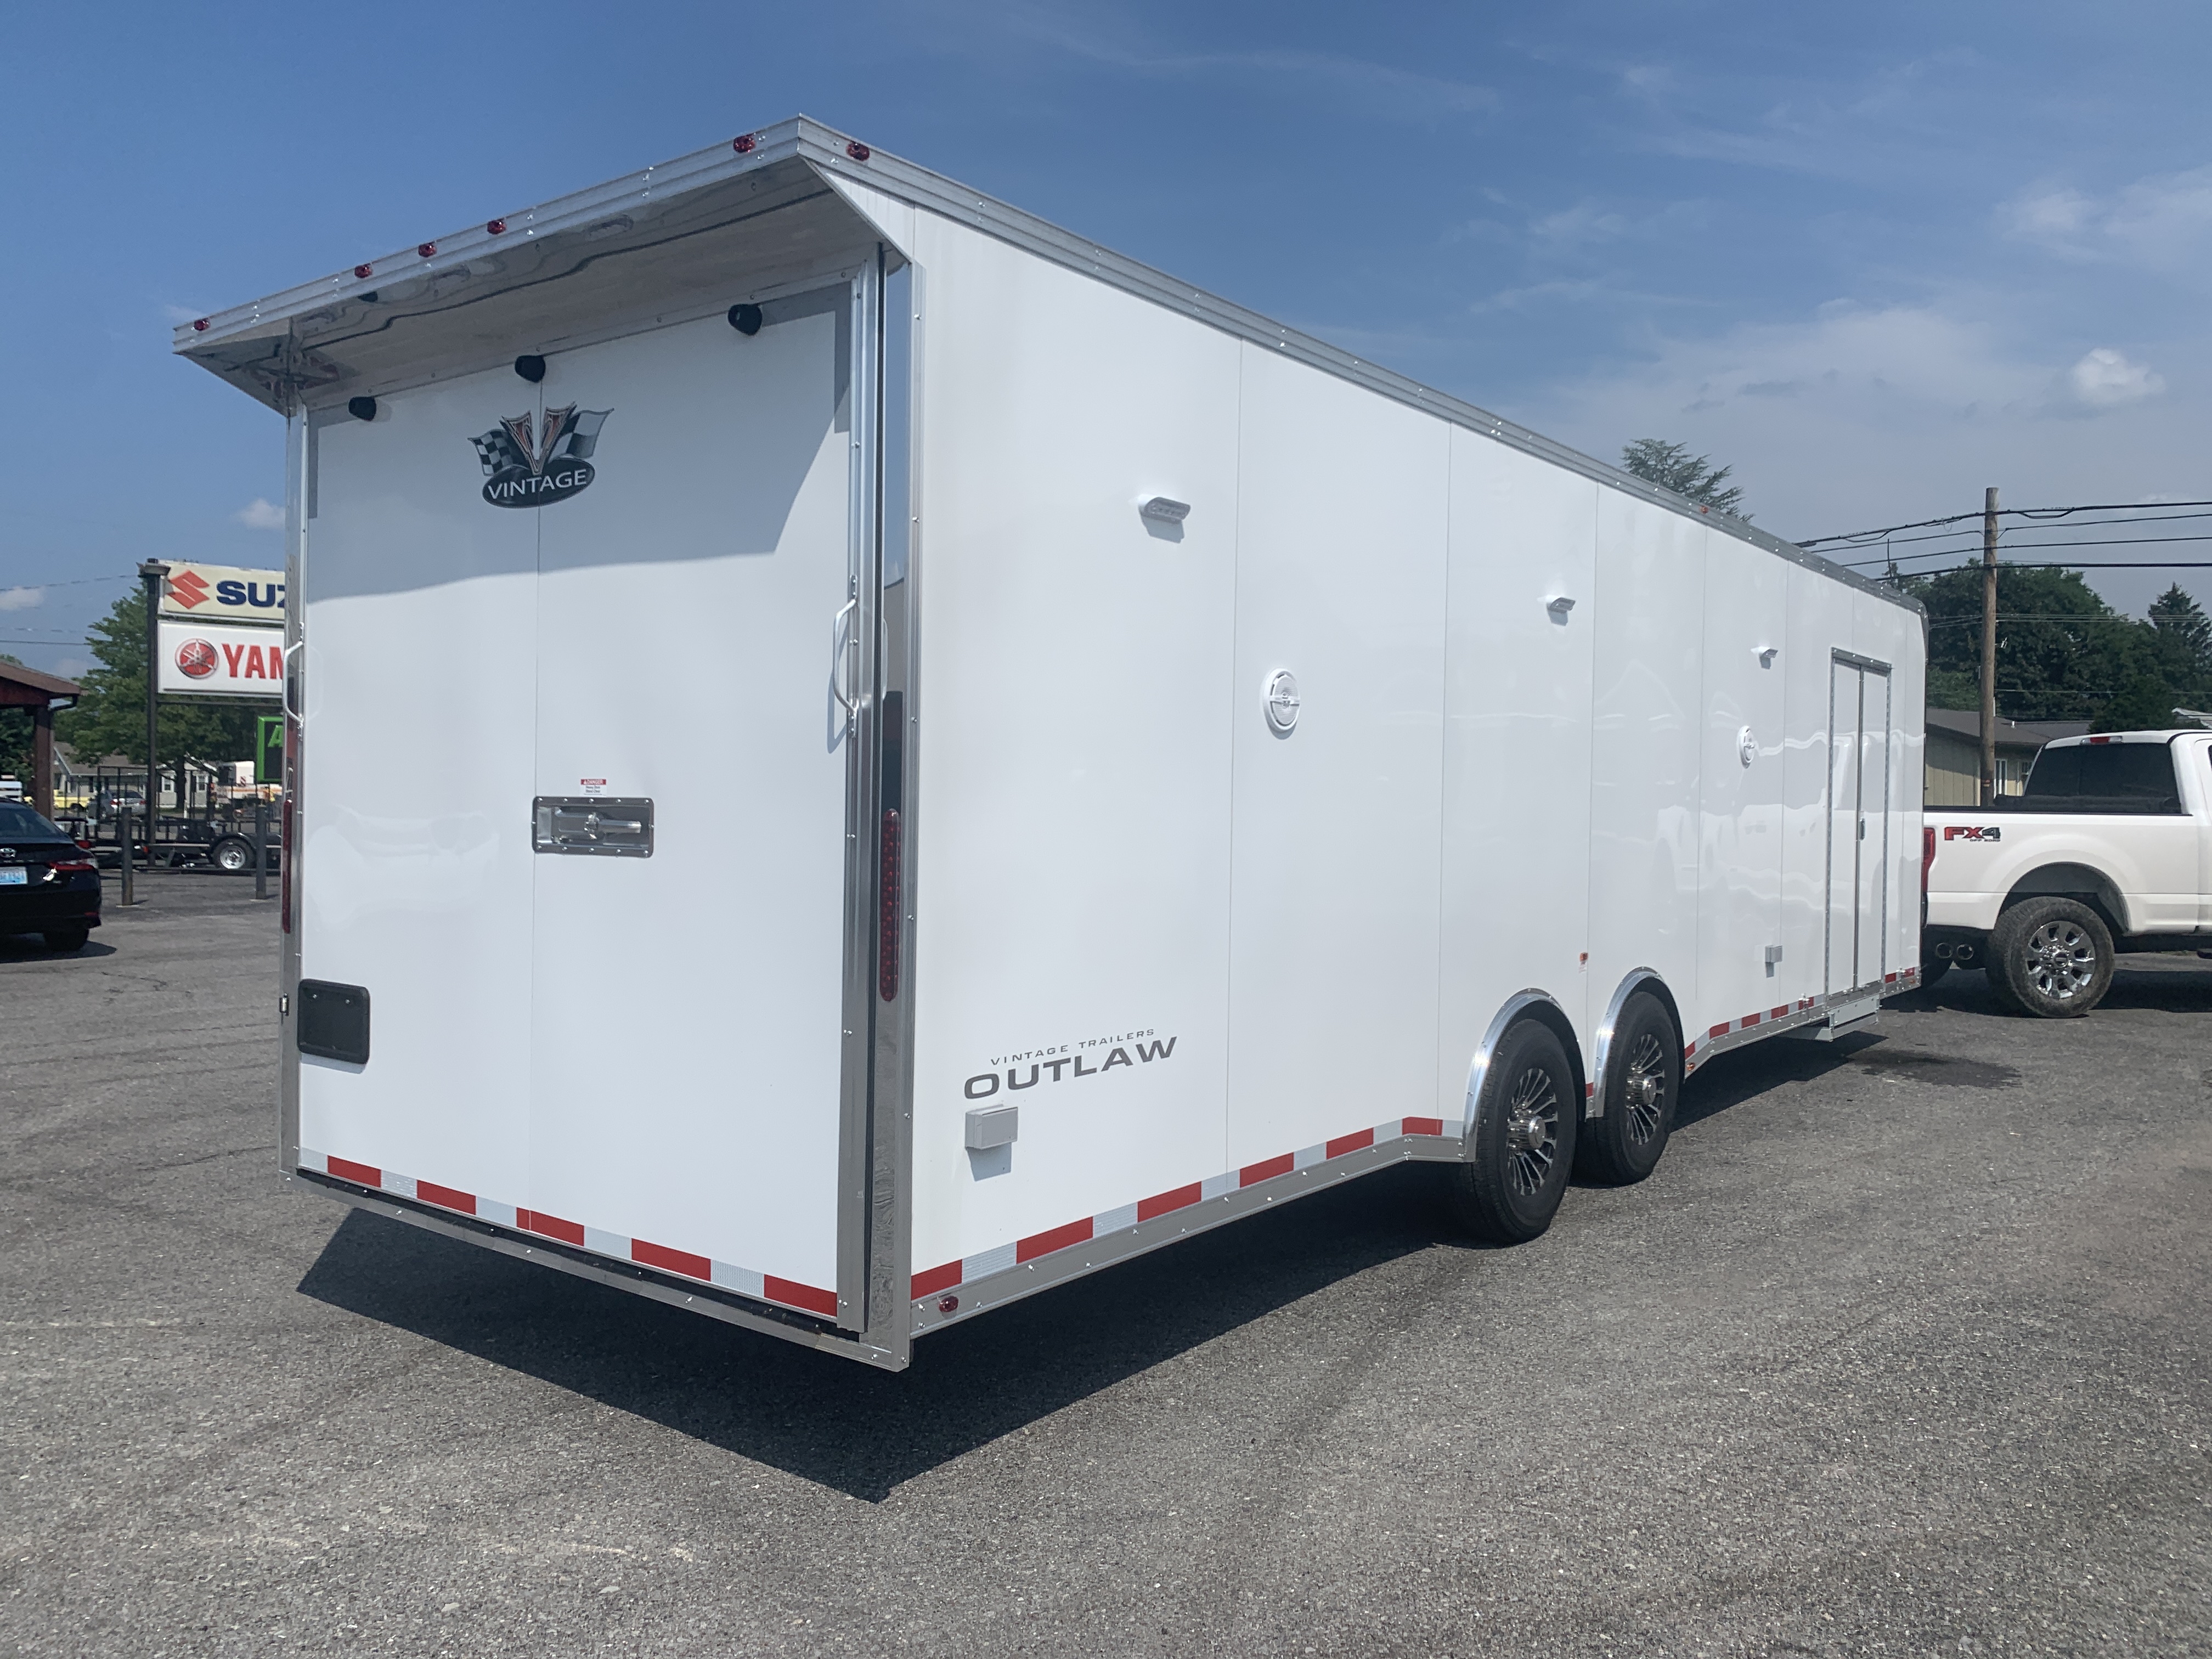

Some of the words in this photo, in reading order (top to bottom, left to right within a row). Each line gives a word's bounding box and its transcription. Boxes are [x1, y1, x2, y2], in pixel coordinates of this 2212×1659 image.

[488, 469, 587, 500] VINTAGE
[216, 580, 285, 609] SU
[1944, 827, 2001, 840] FX4
[990, 1045, 1069, 1066] VINTAGE
[1078, 1028, 1155, 1049] TRAILERS
[964, 1036, 1177, 1099] OUTLAW
